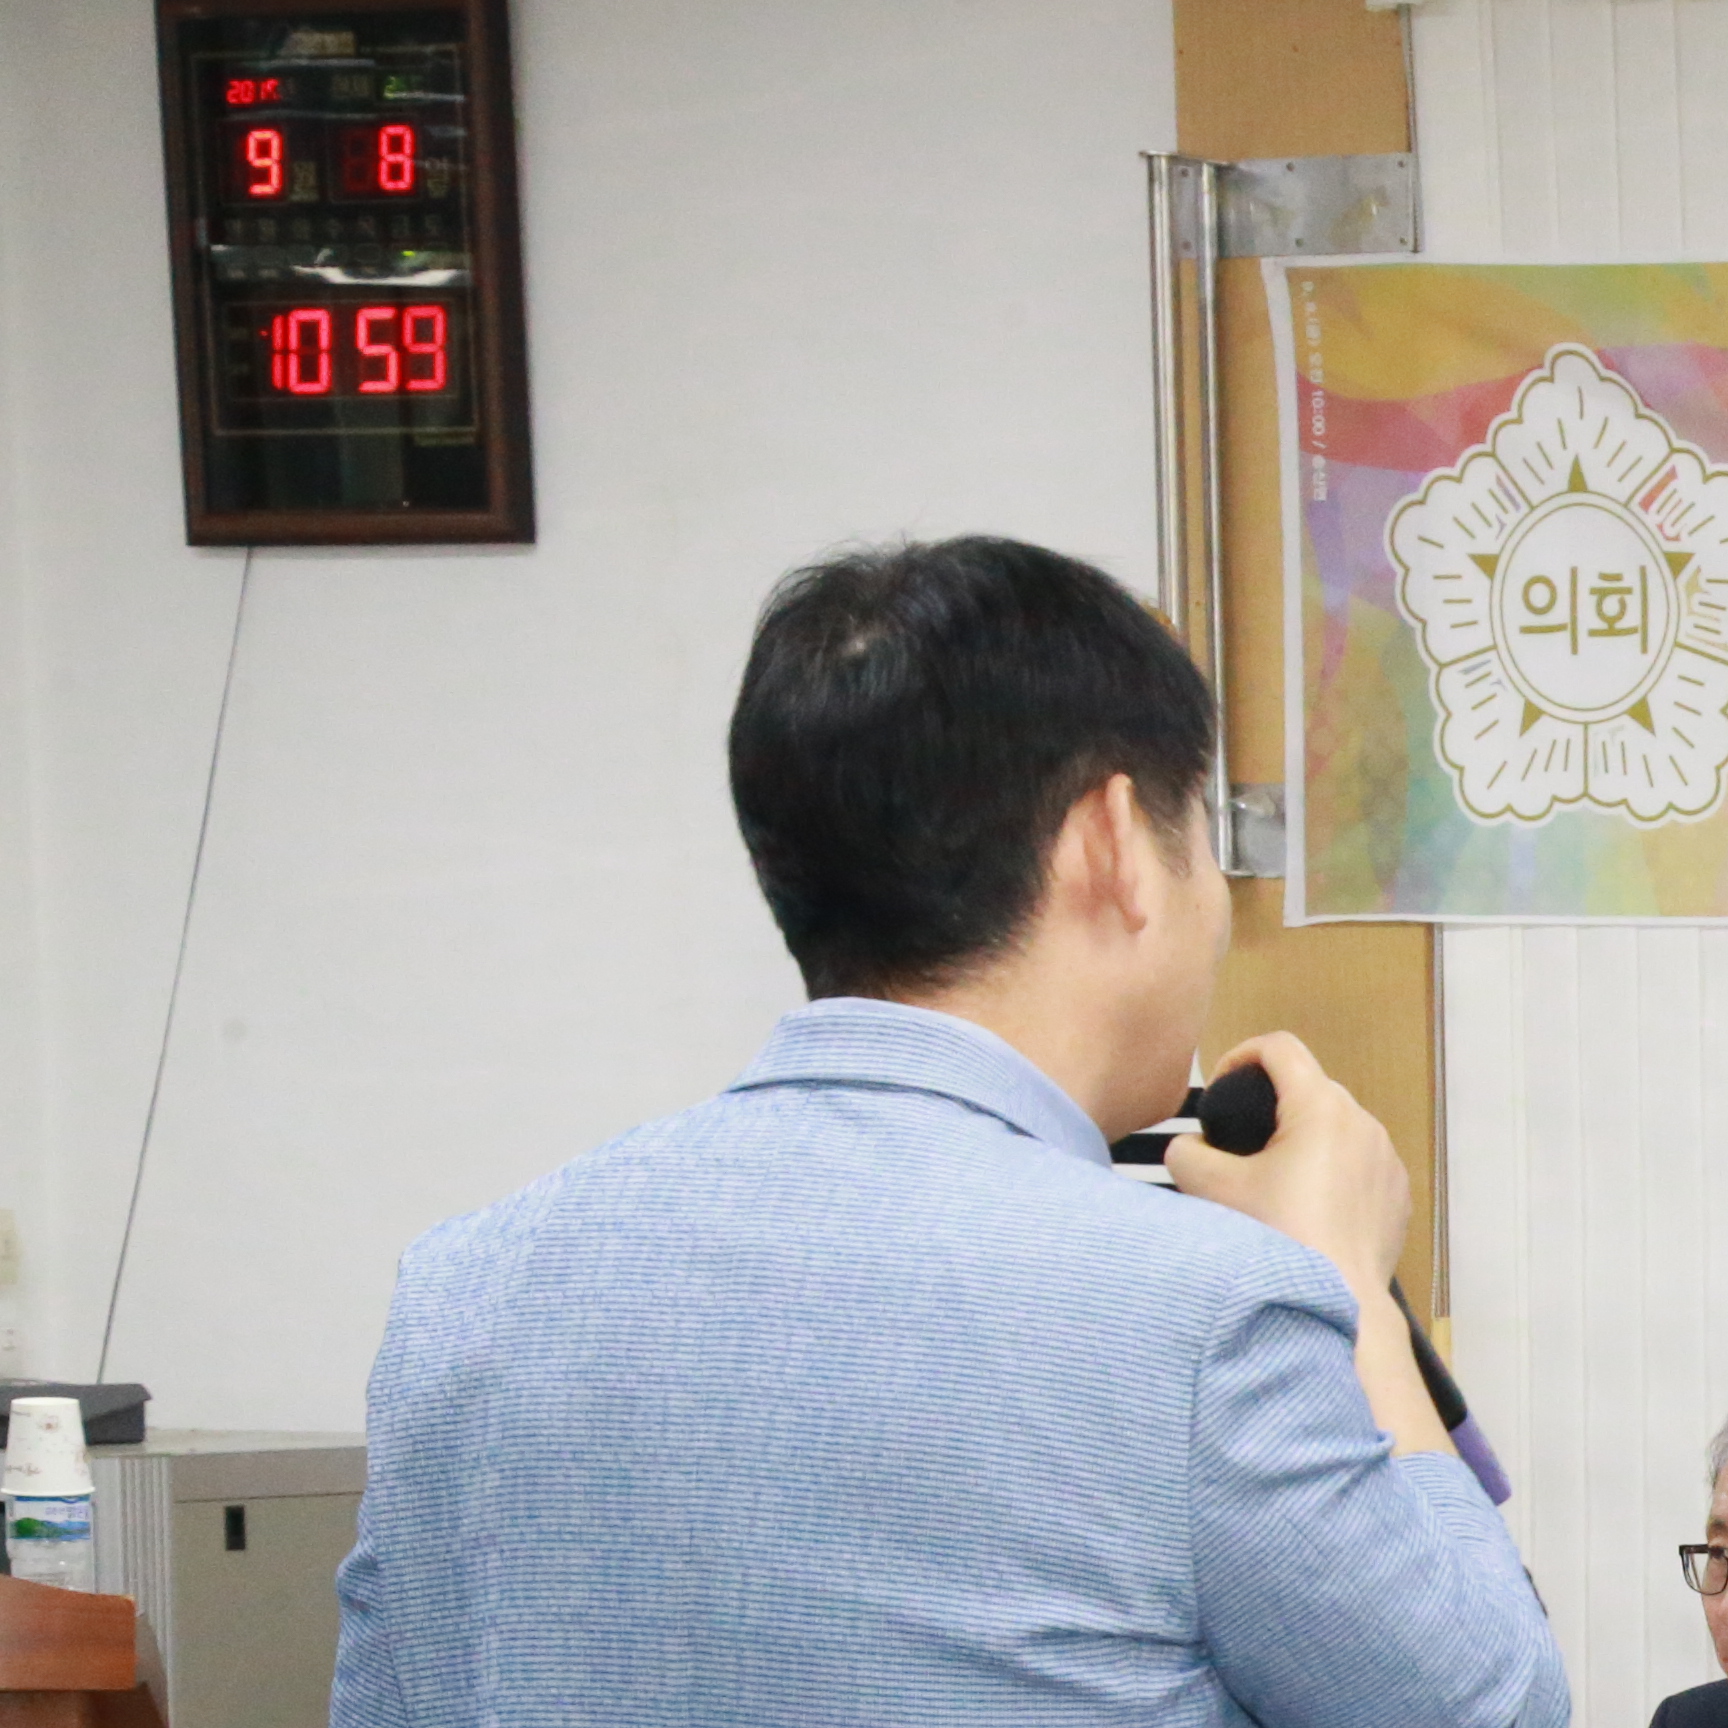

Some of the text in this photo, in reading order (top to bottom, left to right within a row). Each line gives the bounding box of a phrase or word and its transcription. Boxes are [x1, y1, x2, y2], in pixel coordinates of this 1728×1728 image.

[244, 128, 283, 196] 9
[377, 124, 416, 192] 8
[1520, 565, 1650, 656] 의회
